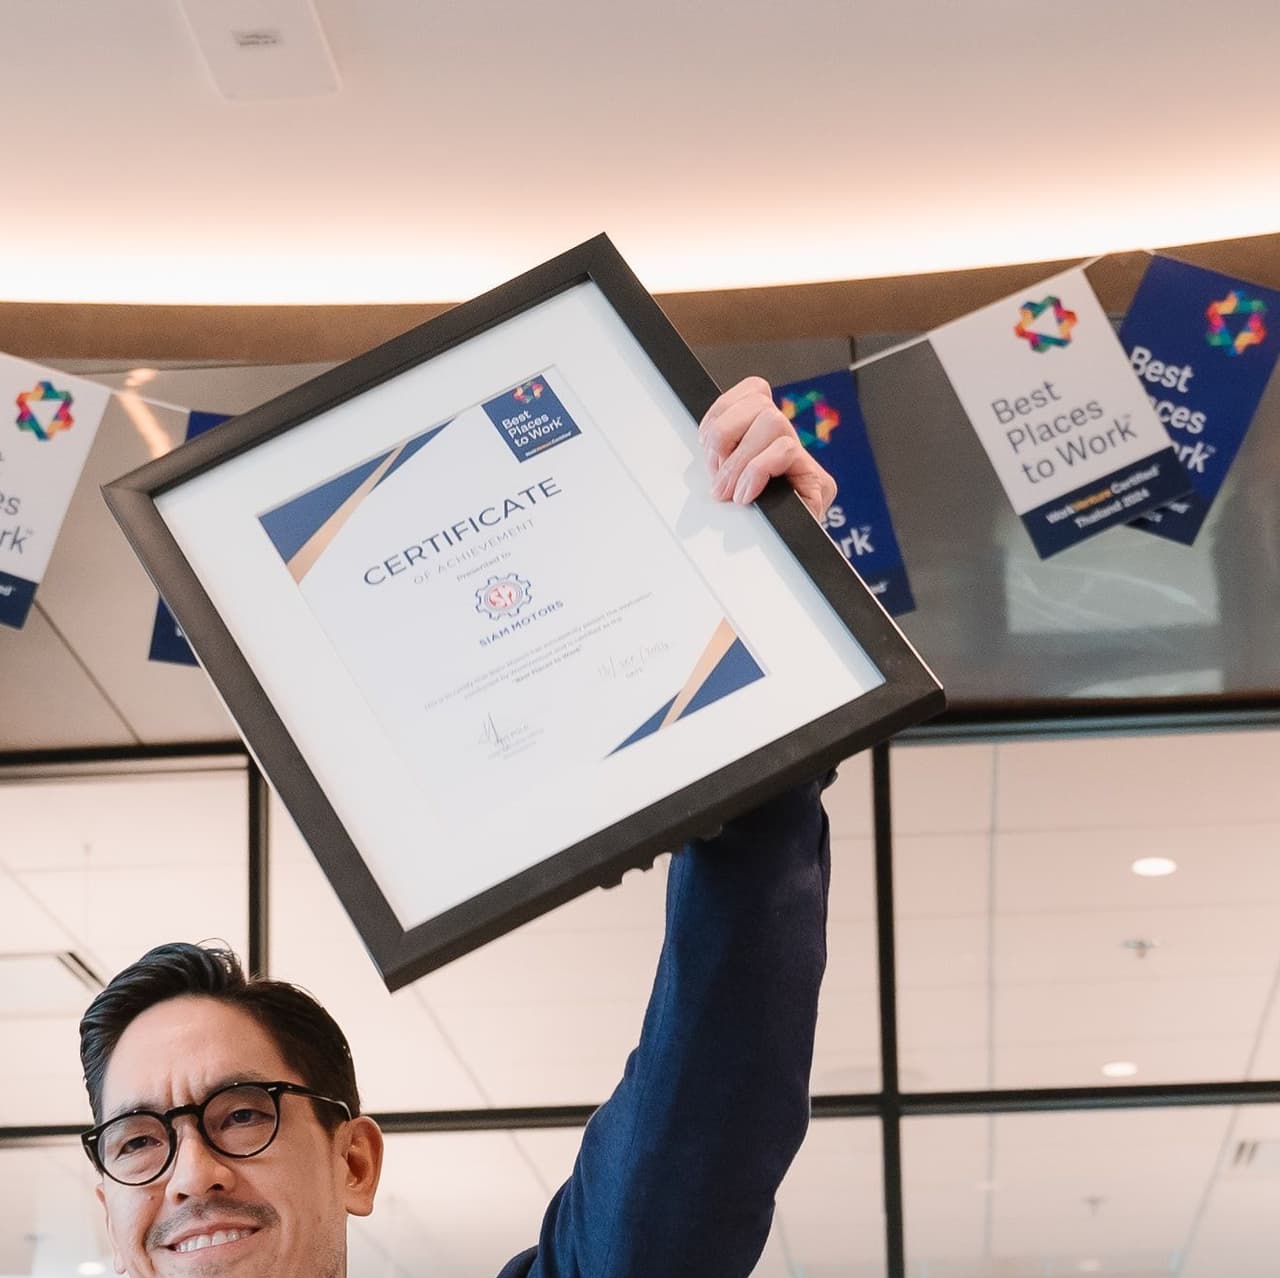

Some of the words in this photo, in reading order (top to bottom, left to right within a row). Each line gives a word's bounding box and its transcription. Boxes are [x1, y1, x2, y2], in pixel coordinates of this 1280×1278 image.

[1130, 346, 1194, 393] Best
[502, 410, 532, 430] Best
[991, 381, 1062, 425] Best
[1154, 398, 1207, 434] ces
[508, 414, 549, 439] Places
[514, 436, 529, 447] to
[528, 418, 563, 440] Work
[1006, 400, 1104, 454] Places
[1021, 459, 1055, 484] to
[1055, 419, 1137, 467] Work
[1175, 441, 1210, 473] rk
[363, 477, 563, 586] CERTIFICATE
[1074, 500, 1121, 529] Thailand
[414, 571, 431, 585] OF
[437, 519, 535, 574] ACHIEVEMENT
[479, 627, 510, 647] SIAM
[511, 600, 564, 631] MOTORS
